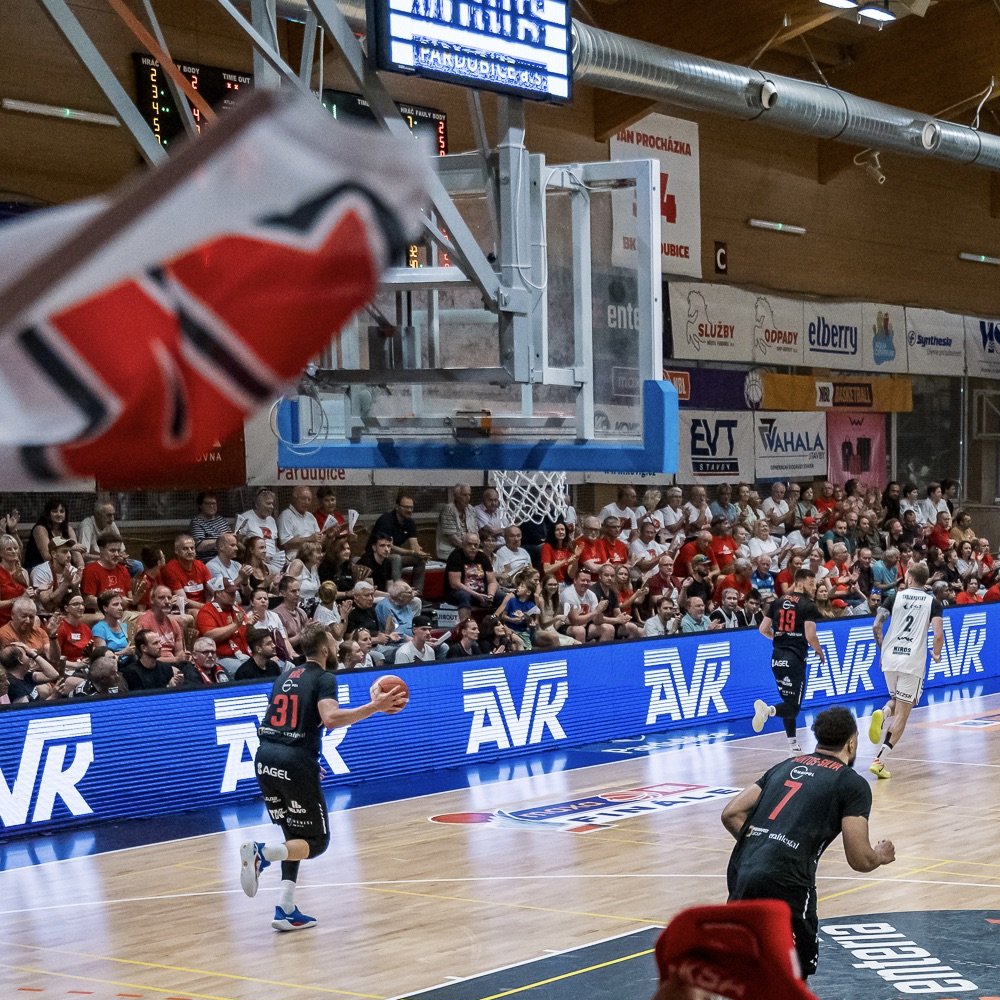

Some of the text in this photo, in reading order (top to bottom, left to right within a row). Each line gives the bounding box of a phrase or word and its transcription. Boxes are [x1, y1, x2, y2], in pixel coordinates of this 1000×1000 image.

[150, 68, 157, 82] 2
[183, 66, 200, 75] BODY
[222, 73, 251, 84] TIME OUT
[191, 75, 198, 89] 2
[152, 85, 158, 98] 3
[152, 102, 159, 114] 4
[636, 131, 692, 157] PROCHÁZKA
[622, 236, 636, 250] BK
[716, 248, 727, 270] C
[698, 321, 735, 339] SLUŽBY
[764, 328, 798, 346] ODPADY
[808, 316, 858, 355] elberry
[916, 335, 953, 348] Synthesia
[690, 418, 738, 456] EVT
[699, 463, 732, 472] STAVBY
[778, 609, 796, 632] 19
[903, 615, 914, 632] 2
[927, 611, 987, 681] AVR
[774, 660, 790, 668] AGEL
[804, 625, 877, 700] AVR
[643, 641, 731, 725] AVR
[270, 693, 299, 730] 31
[462, 659, 568, 754] AVR
[0, 713, 94, 828] VR
[262, 765, 291, 781] AGEL
[768, 779, 803, 820] 7
